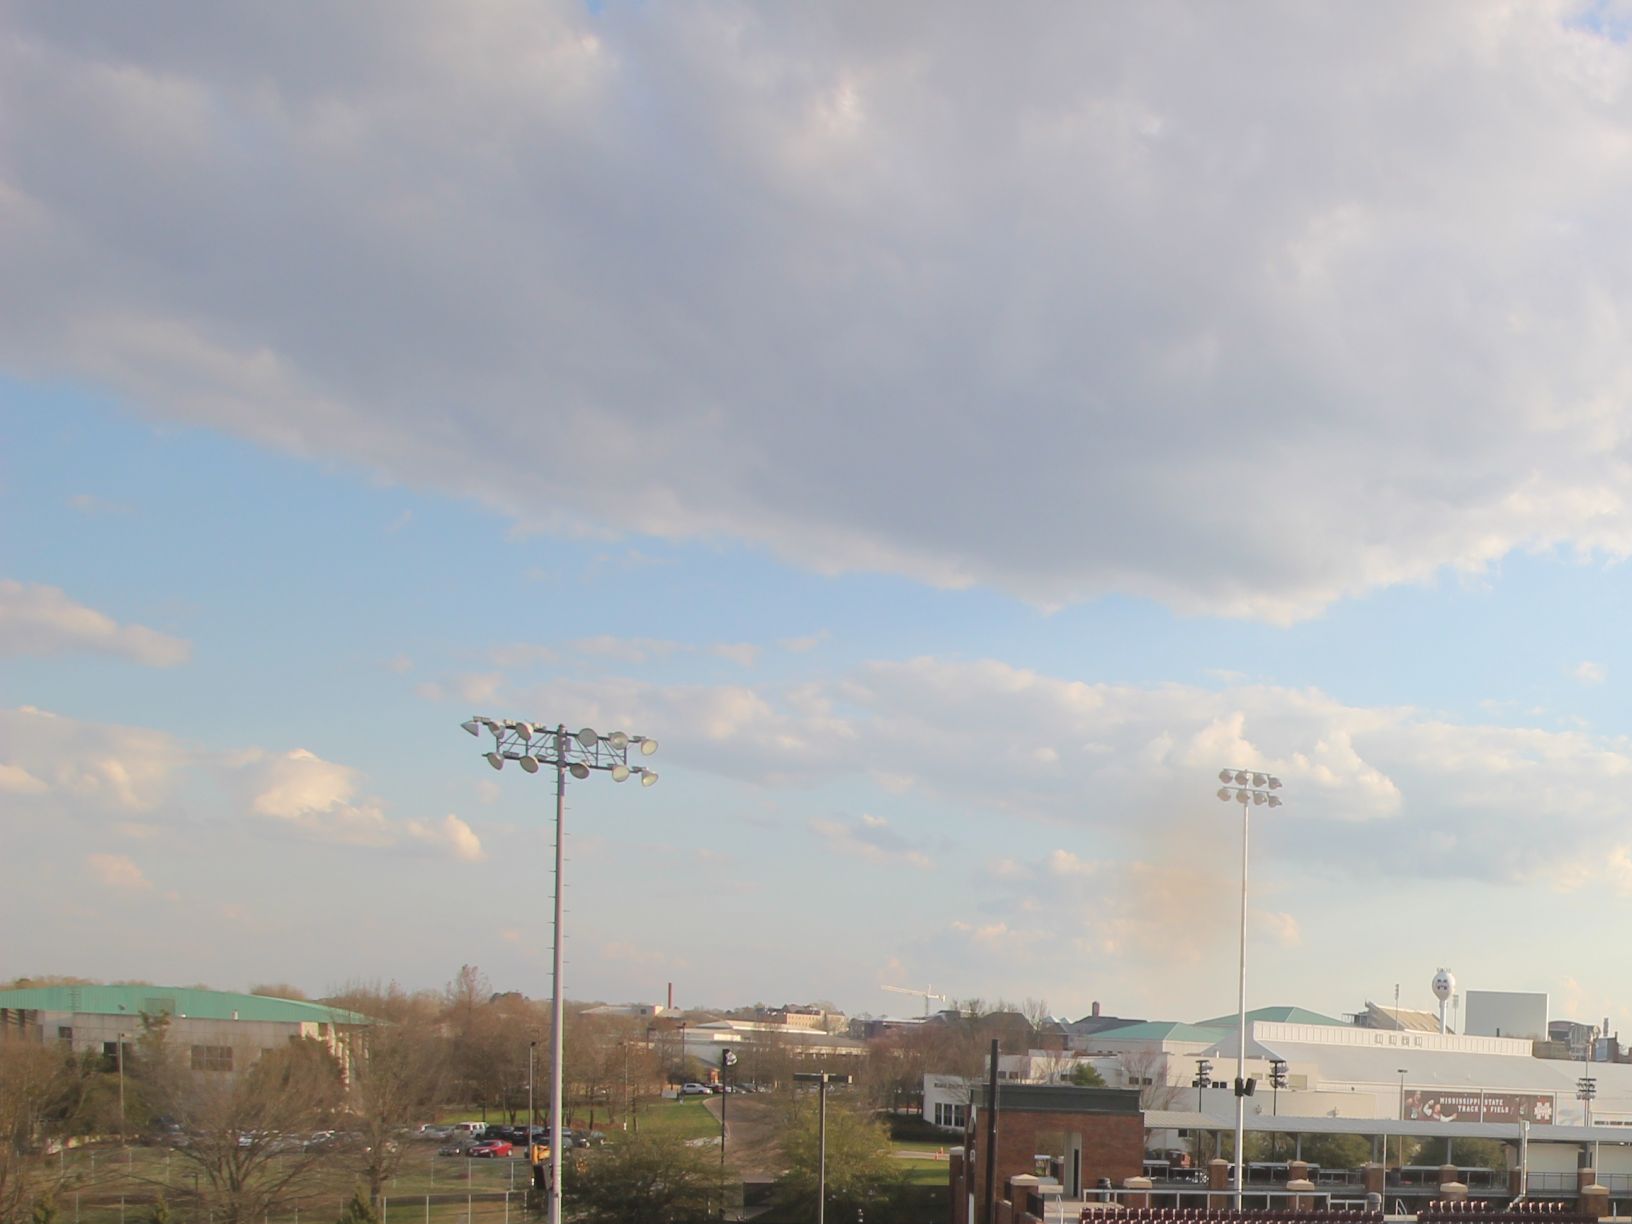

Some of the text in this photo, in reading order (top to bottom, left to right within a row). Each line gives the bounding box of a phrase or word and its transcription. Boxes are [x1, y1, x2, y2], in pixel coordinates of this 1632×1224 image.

[1440, 1097, 1504, 1106] MISSISSIPPI STATE
[1457, 1105, 1479, 1113] TRACK
[1490, 1106, 1509, 1114] FIELD
